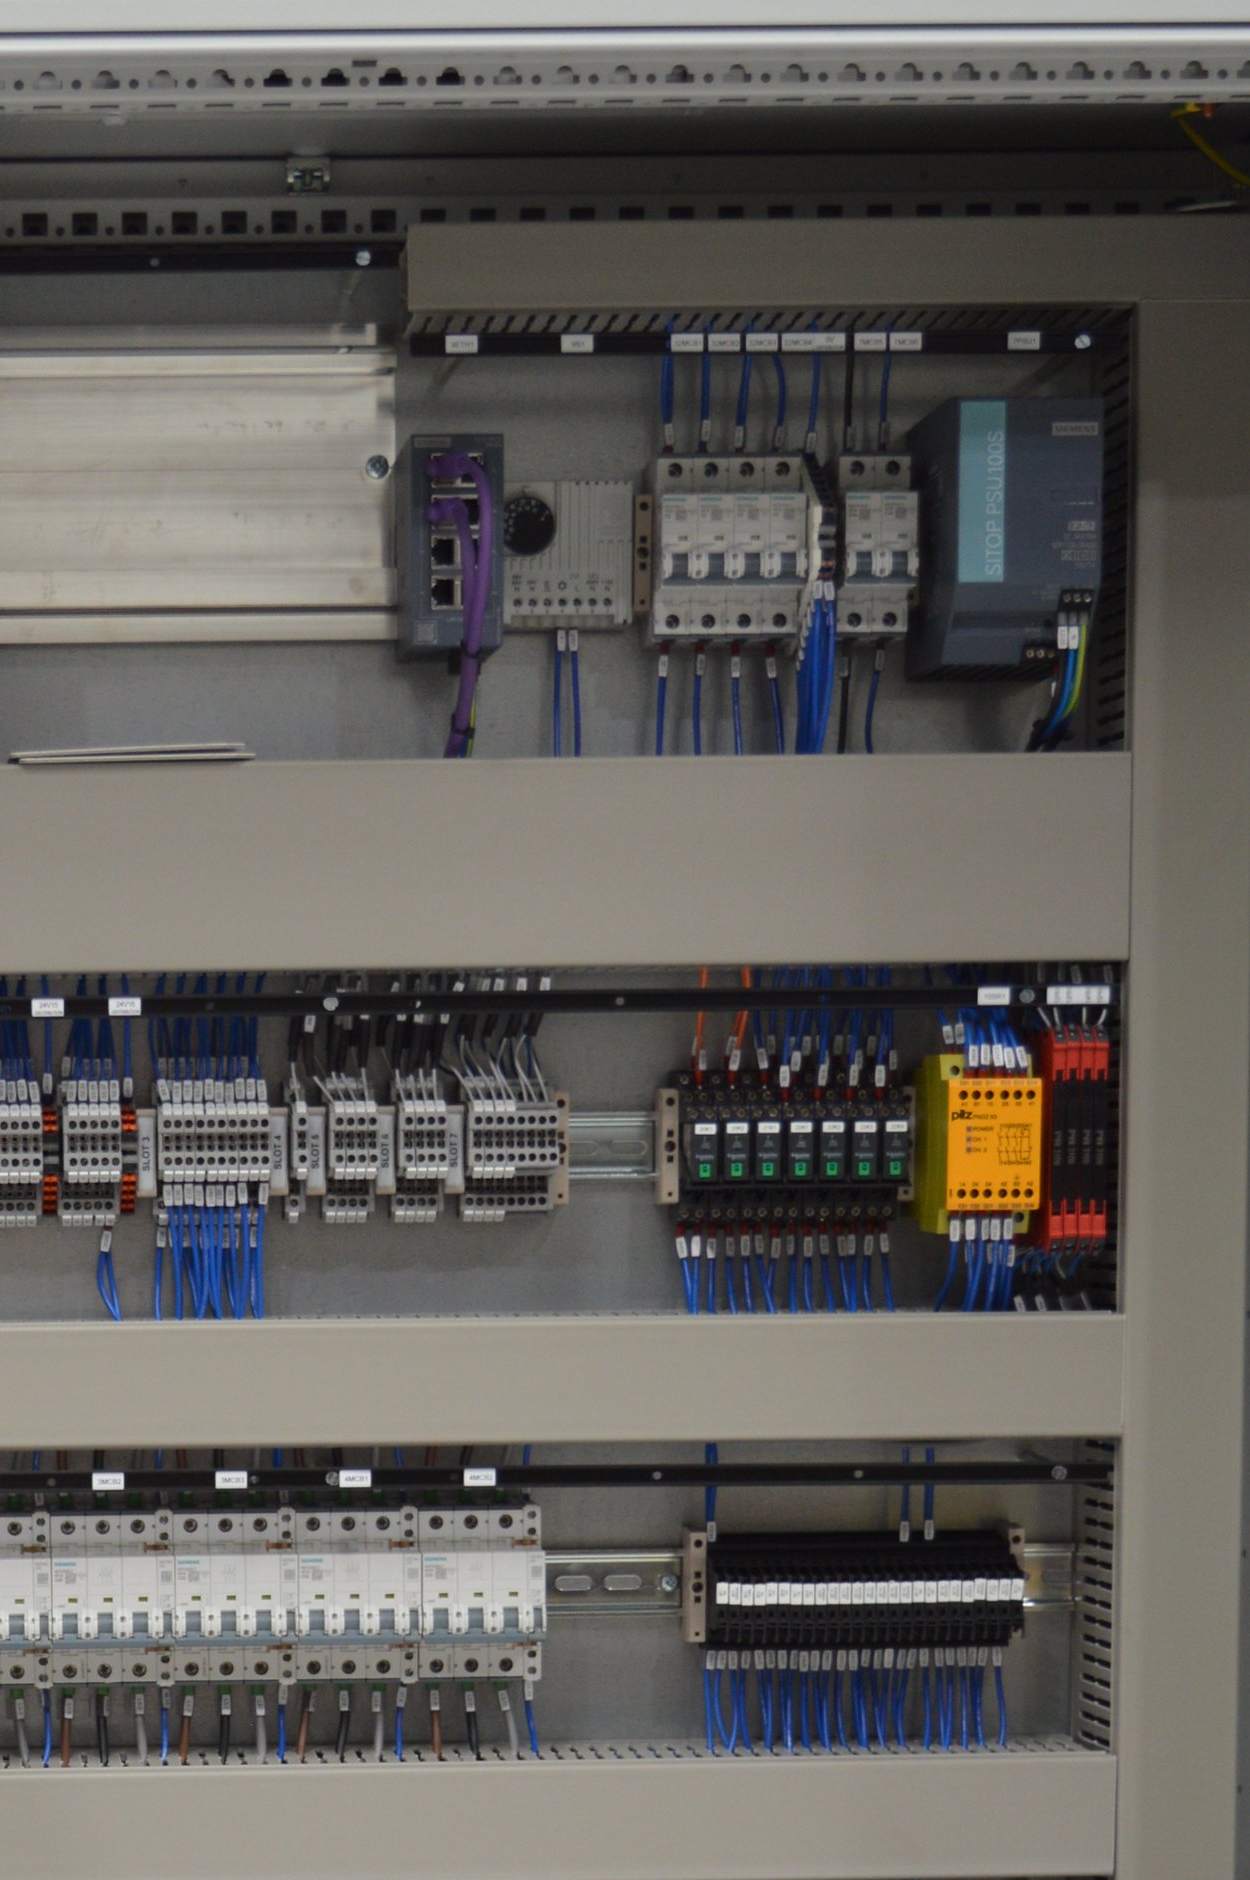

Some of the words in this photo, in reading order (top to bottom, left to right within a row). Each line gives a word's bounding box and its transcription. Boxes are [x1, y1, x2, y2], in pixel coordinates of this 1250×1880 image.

[1054, 424, 1096, 434] SIEMENS
[986, 430, 1004, 515] PSU100S
[985, 520, 1002, 576] SITOP
[952, 1110, 972, 1120] pilz
[142, 1144, 150, 1172] SLOT
[274, 1142, 282, 1170] SLOT
[311, 1142, 319, 1168] SLOT
[381, 1142, 389, 1168] SLOT
[450, 1141, 458, 1168] SLOT
